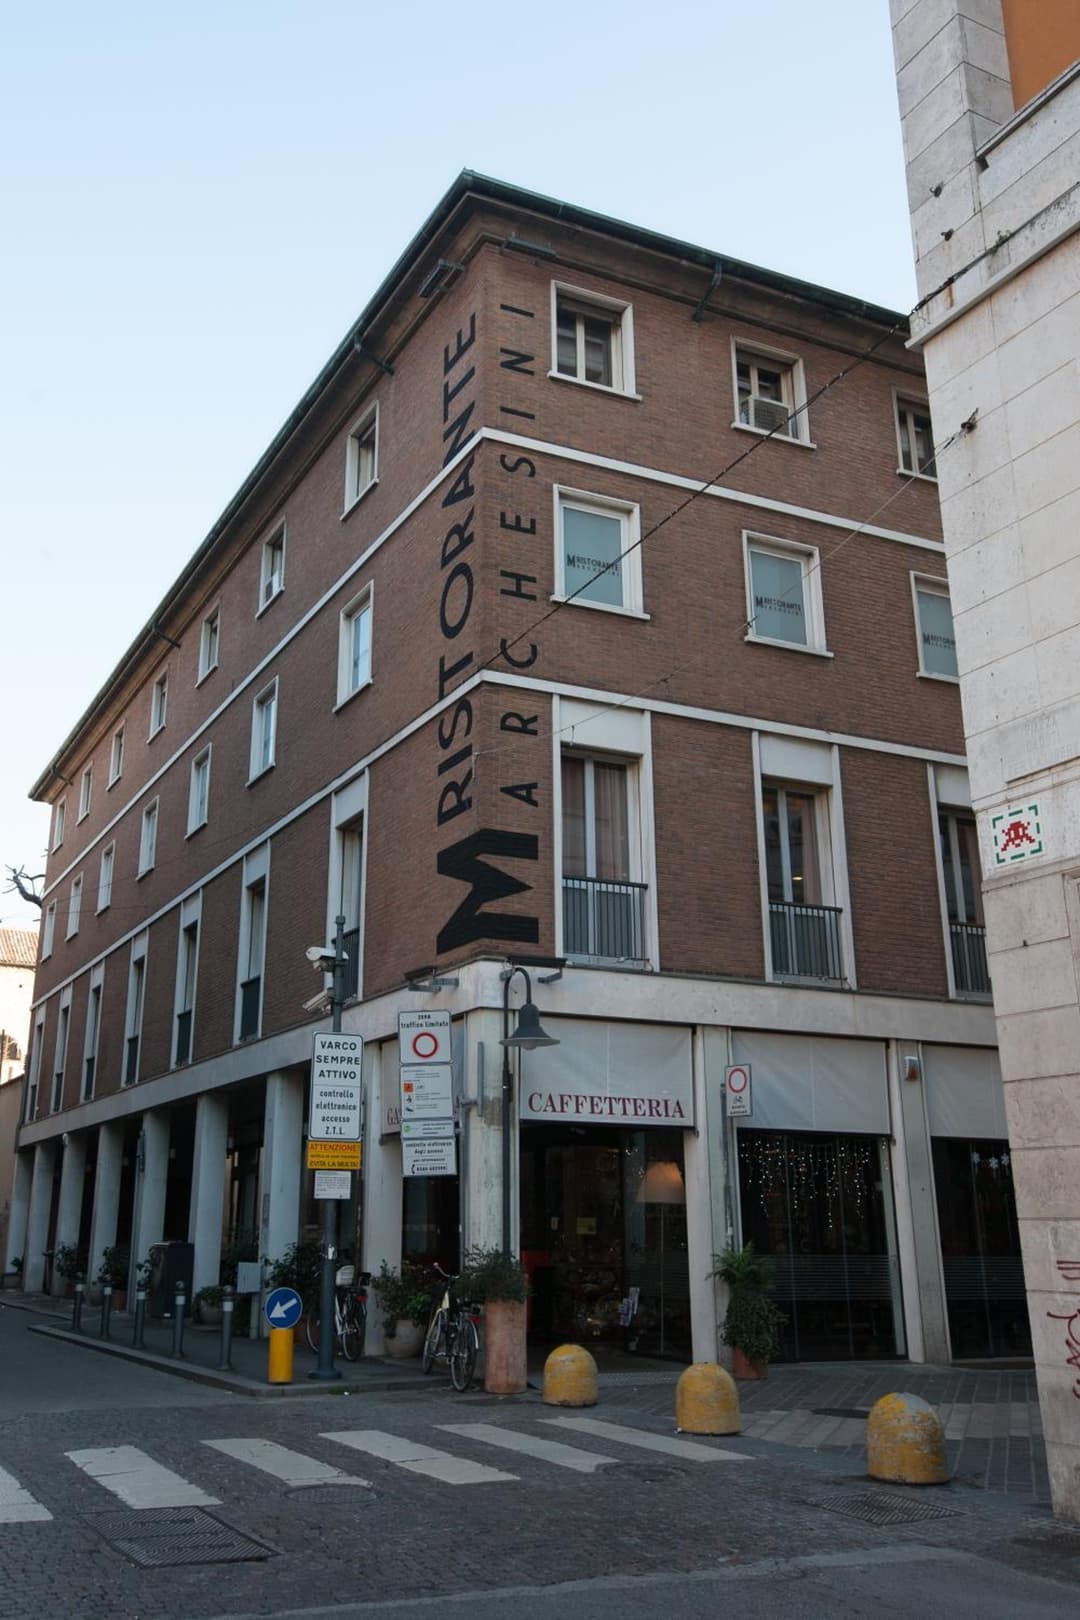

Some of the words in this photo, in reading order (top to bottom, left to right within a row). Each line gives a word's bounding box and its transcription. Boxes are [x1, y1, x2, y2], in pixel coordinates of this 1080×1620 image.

[437, 312, 476, 826] RISTORANTE
[320, 1040, 357, 1051] VARCO
[316, 1055, 360, 1065] SEMPRE
[318, 1069, 357, 1080] ATTIVO
[319, 1089, 354, 1099] controllo
[315, 1100, 357, 1111] elettronico
[528, 1091, 685, 1119] CAFFETTERIA
[321, 1115, 350, 1123] accesso
[325, 1126, 345, 1136] Z.T.L.
